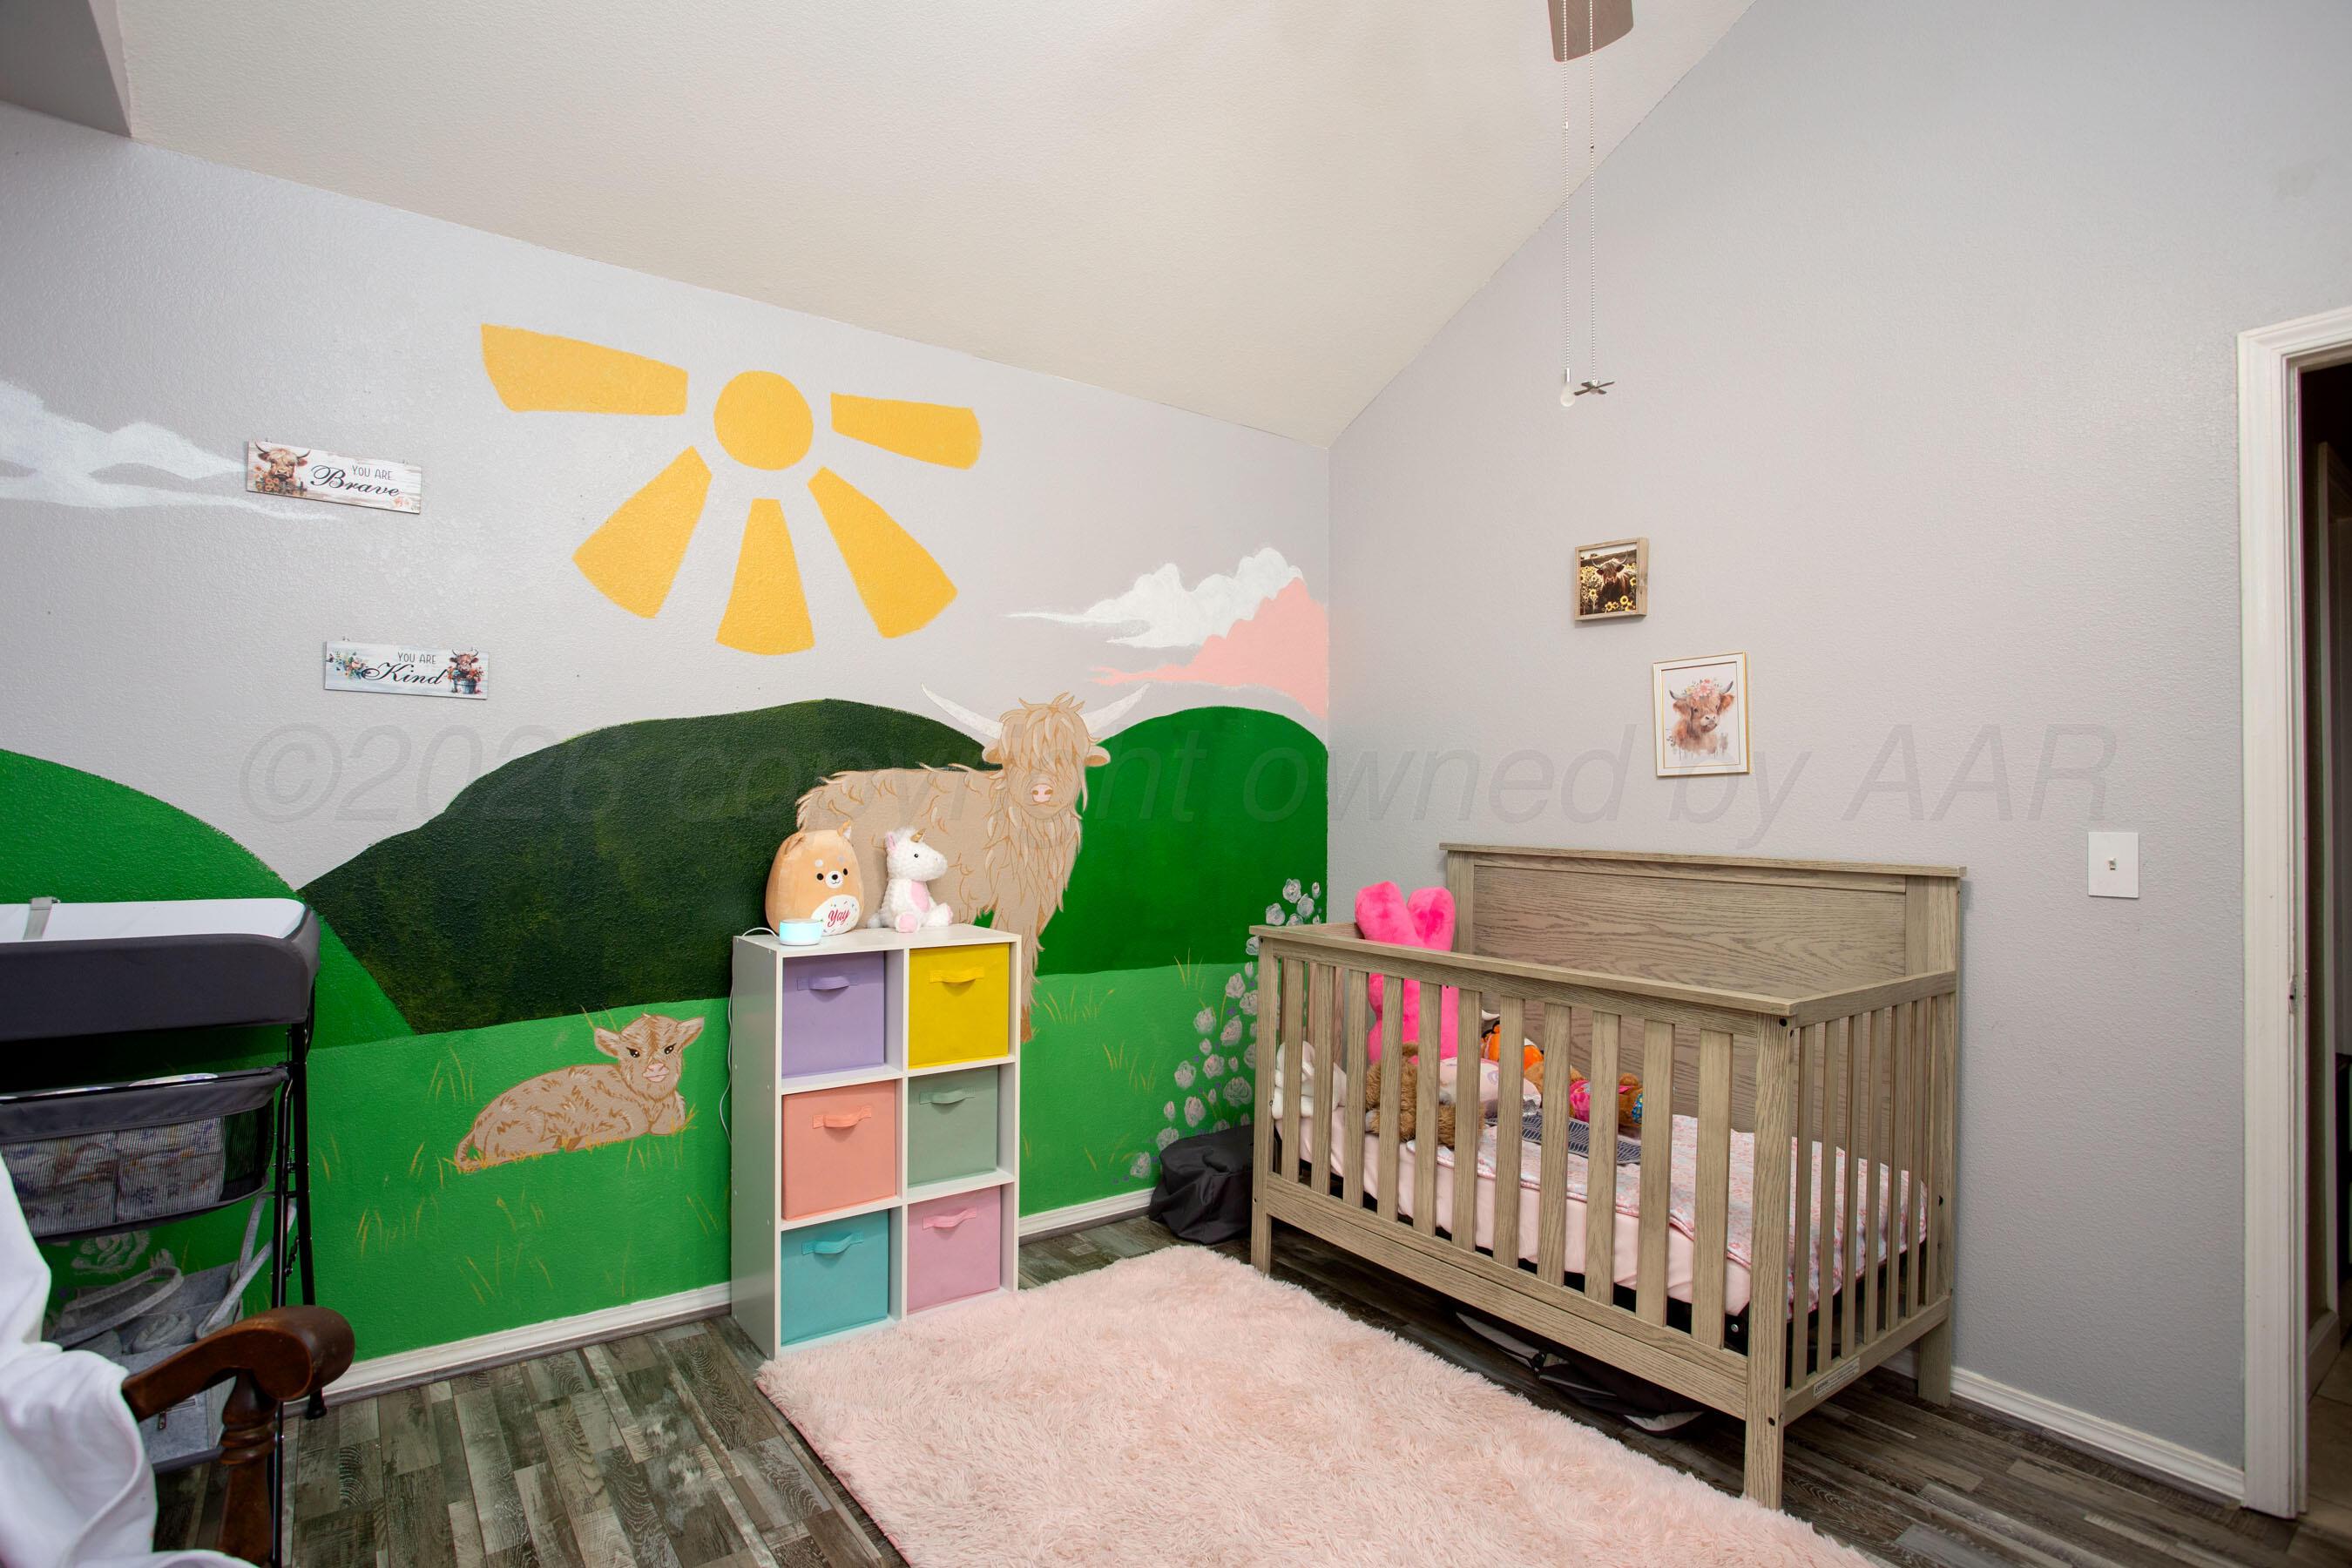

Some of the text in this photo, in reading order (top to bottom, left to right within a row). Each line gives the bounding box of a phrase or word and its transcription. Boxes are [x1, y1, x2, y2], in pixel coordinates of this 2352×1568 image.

[310, 464, 401, 497] Brave
[351, 464, 394, 481] YOU ARE
[397, 652, 437, 665] YOU ARE
[361, 662, 448, 685] Kind
